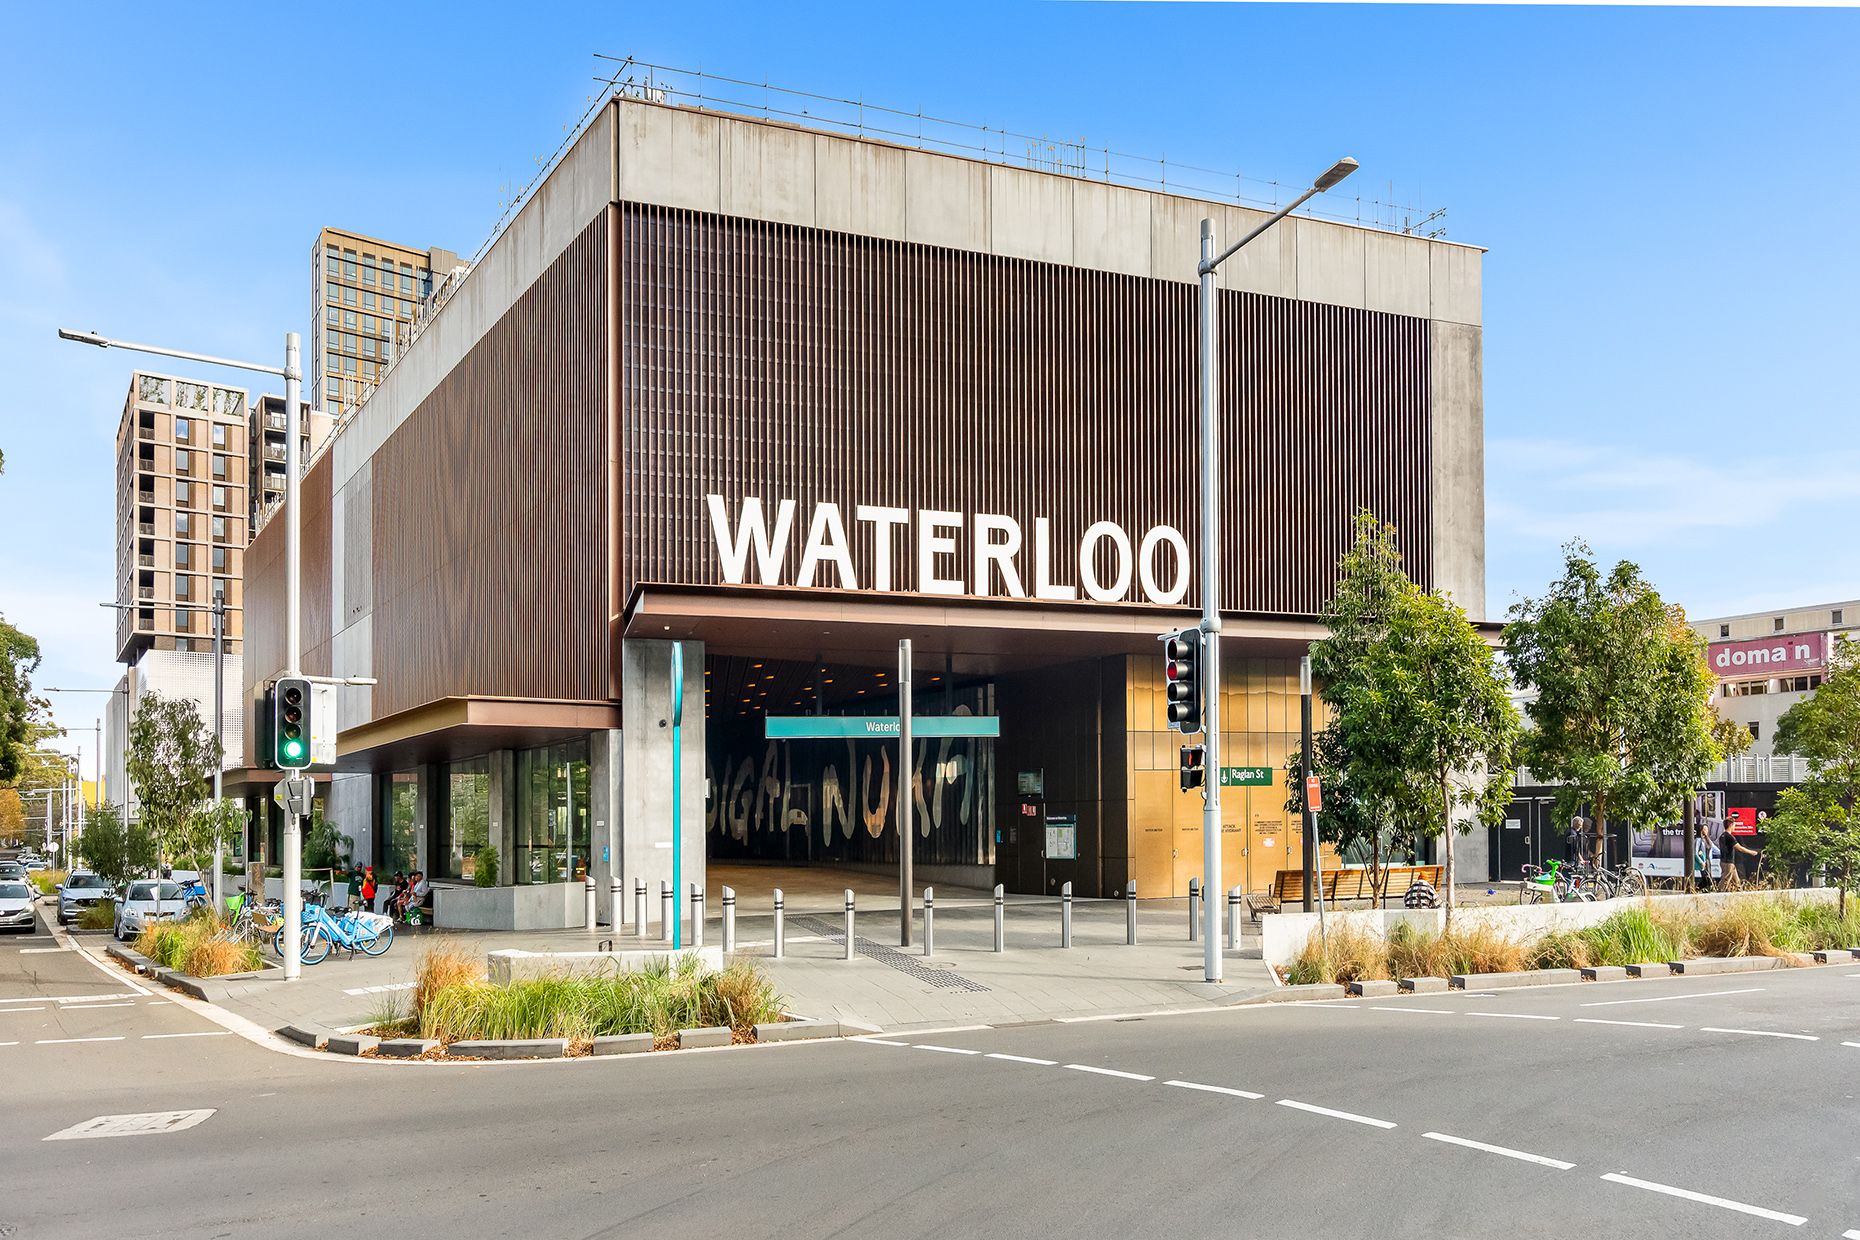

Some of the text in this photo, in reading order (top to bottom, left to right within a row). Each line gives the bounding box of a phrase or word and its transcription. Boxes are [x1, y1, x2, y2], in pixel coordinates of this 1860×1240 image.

[706, 494, 1191, 606] WATERLOO
[865, 721, 901, 732] Waterlo
[1231, 769, 1264, 781] Raglan St
[1662, 828, 1675, 836] the
